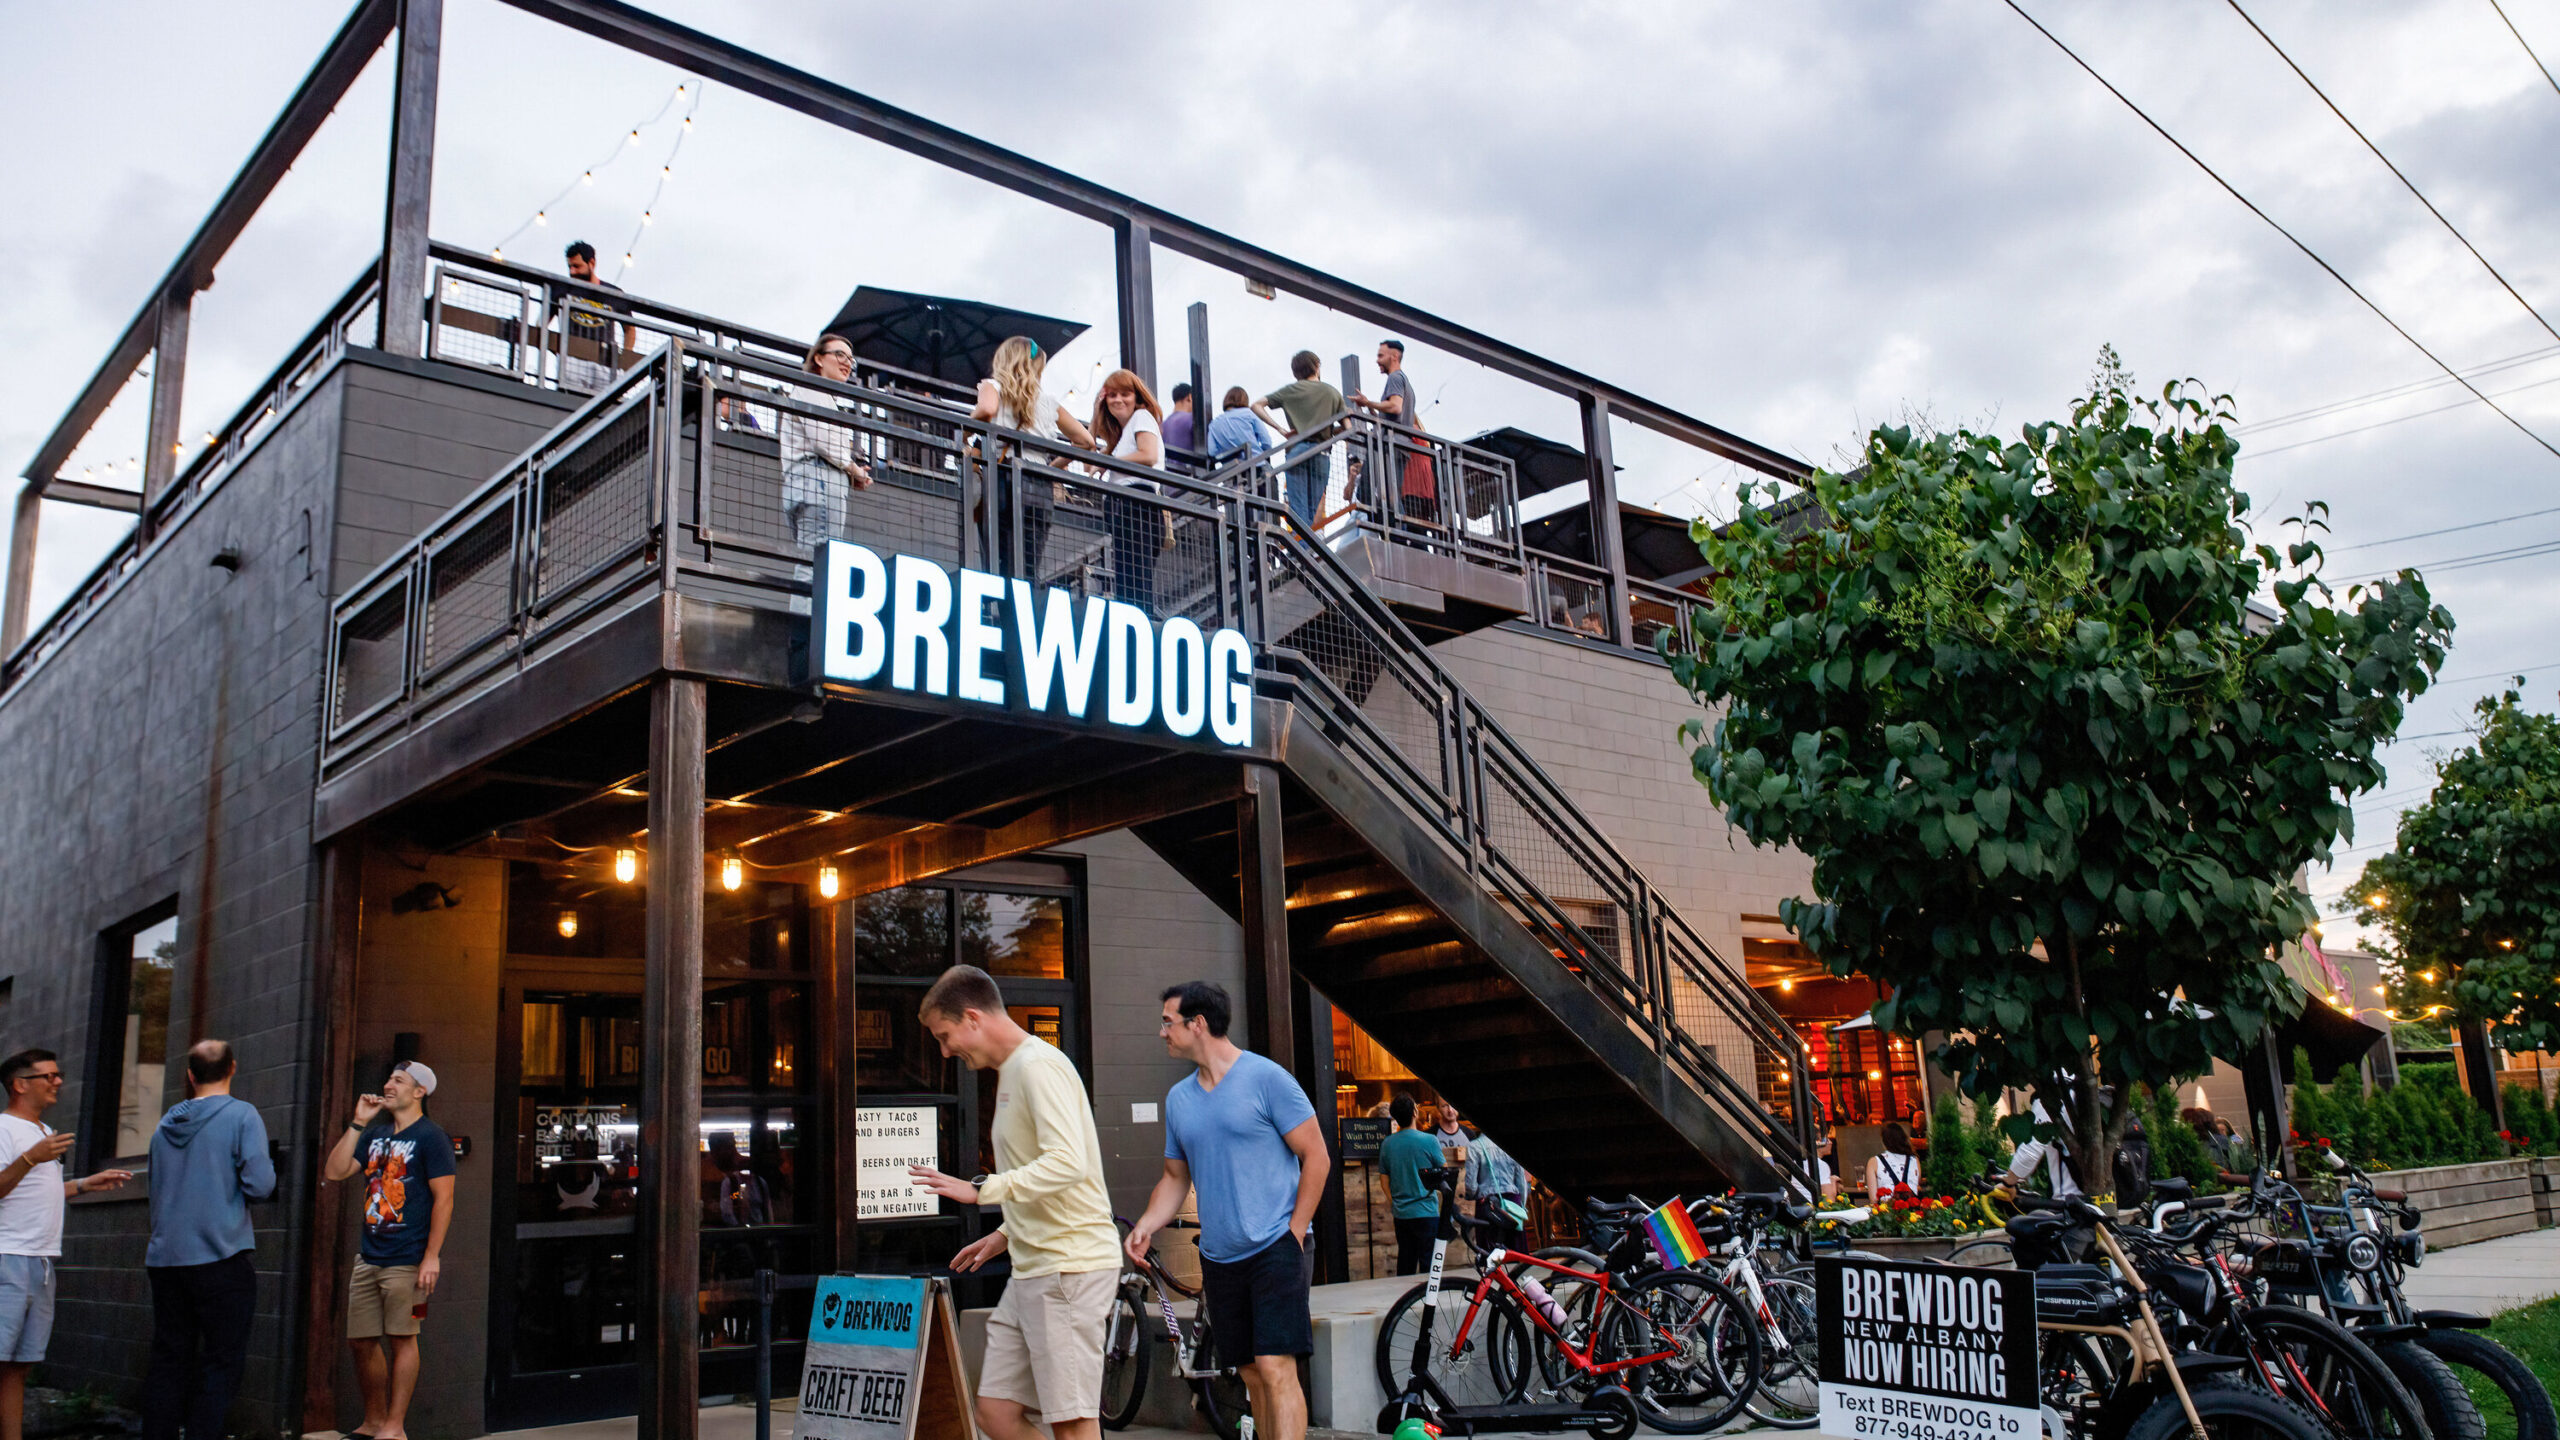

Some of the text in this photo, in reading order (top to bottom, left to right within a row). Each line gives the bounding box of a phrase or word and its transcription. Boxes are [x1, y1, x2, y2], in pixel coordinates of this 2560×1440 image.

[823, 539, 1253, 748] BREWDOG
[536, 1112, 621, 1127] CONTAINS
[857, 1111, 918, 1122] ASTY TACOS
[878, 1127, 920, 1137] BURGERS
[1353, 1123, 1378, 1131] Please
[535, 1128, 618, 1142] BARK AND
[1345, 1132, 1363, 1141] Wait
[1365, 1132, 1375, 1141] To
[1353, 1142, 1380, 1150] Seated
[862, 1156, 937, 1168] BEERS ON DRAFT
[880, 1188, 898, 1198] BAR
[905, 1187, 913, 1197] IS
[883, 1202, 928, 1213] NEGATIVE
[1429, 1252, 1444, 1293] BIRD
[1841, 1267, 2004, 1333] BREWDOG
[842, 1299, 913, 1333] BREWDOG
[1843, 1319, 2004, 1352] NEW ALBANY
[1844, 1337, 2007, 1399] NOW HIRING
[804, 1370, 906, 1419] CRAFT BEER
[1835, 1391, 2019, 1433] Text BREWDOG to
